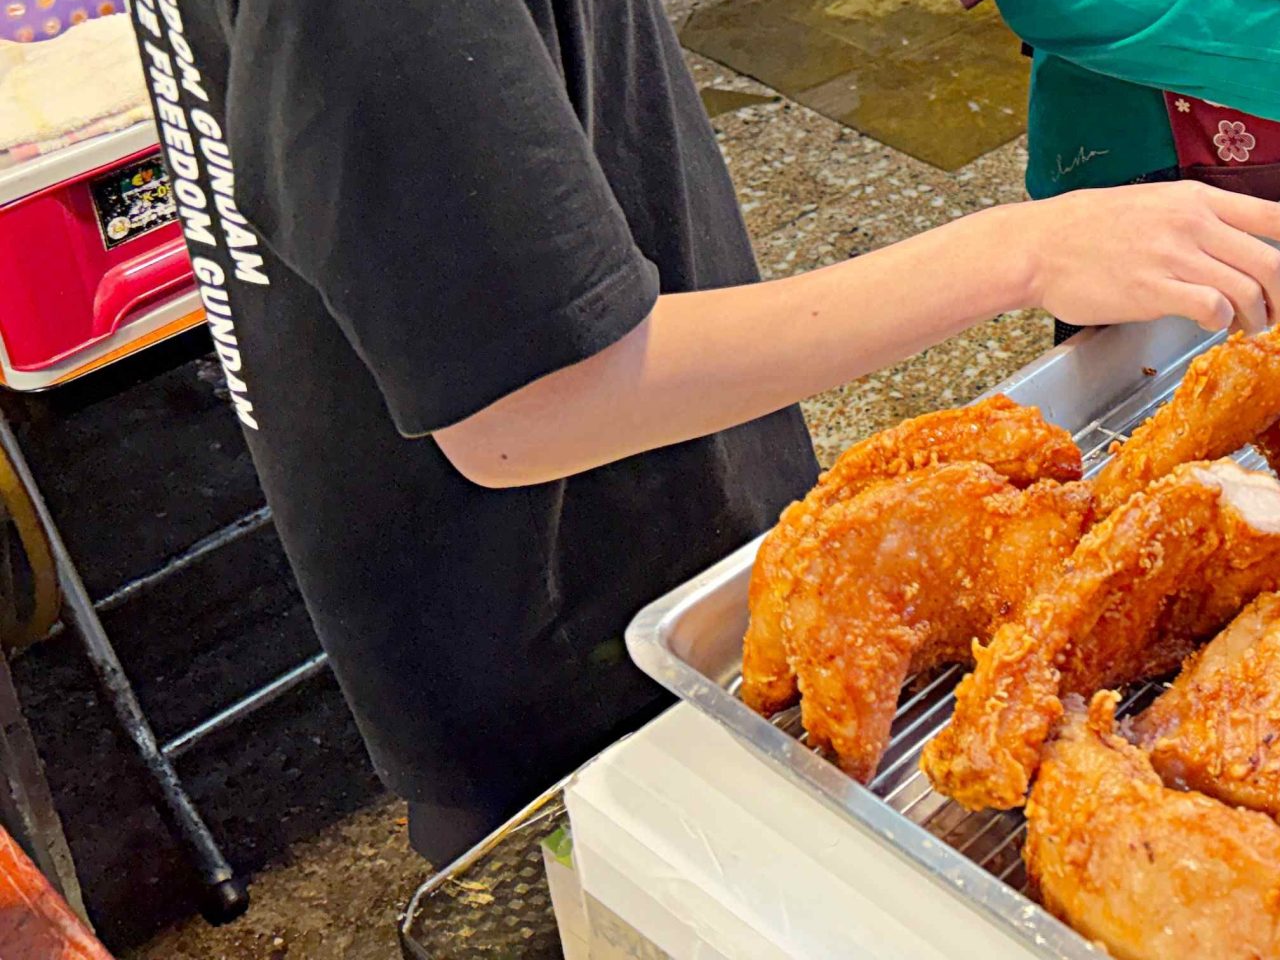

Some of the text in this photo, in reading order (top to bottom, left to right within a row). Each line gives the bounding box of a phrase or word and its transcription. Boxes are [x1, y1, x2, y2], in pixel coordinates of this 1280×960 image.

[145, 41, 217, 248] FREEDOM
[194, 259, 259, 431] GUNDAM
[191, 107, 270, 286] GUNDAM
